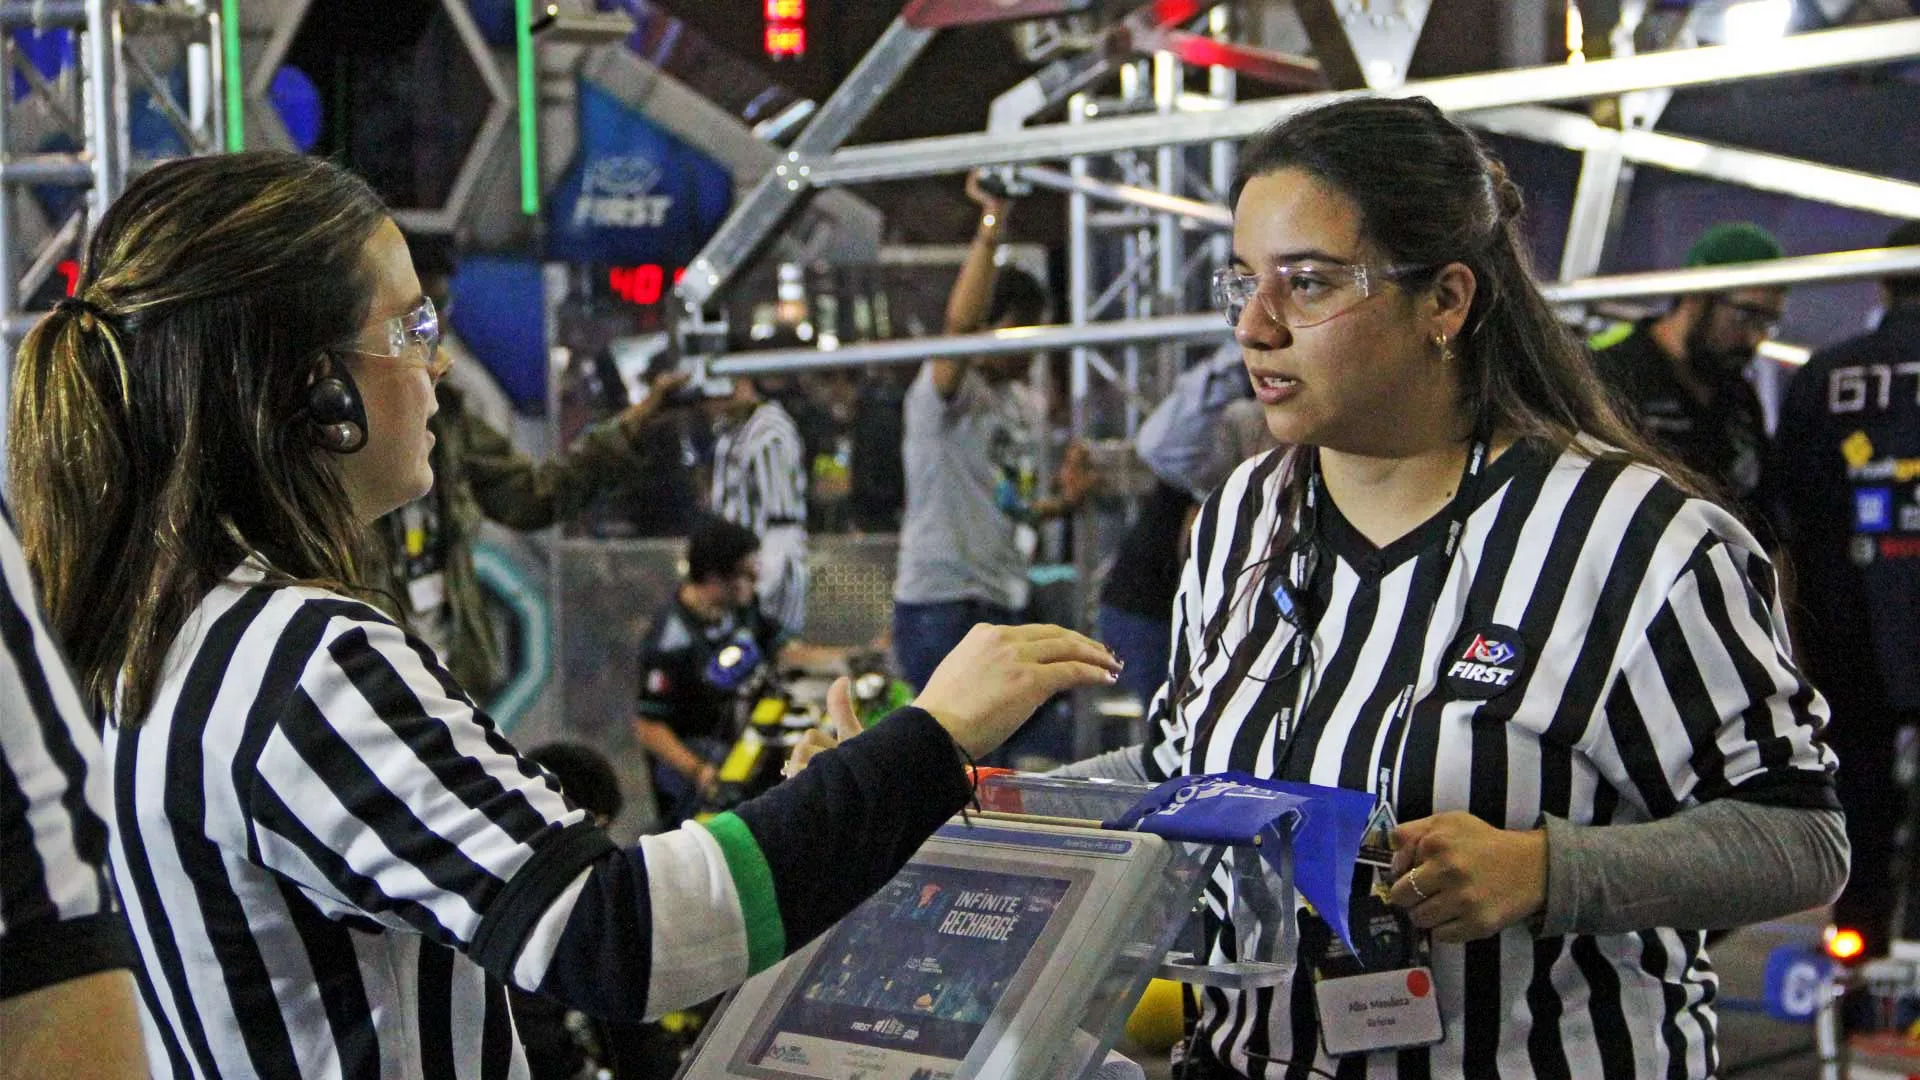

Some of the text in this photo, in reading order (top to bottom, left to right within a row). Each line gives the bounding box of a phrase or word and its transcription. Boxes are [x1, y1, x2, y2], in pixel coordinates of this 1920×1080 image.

[1447, 660, 1514, 686] FIRST
[955, 889, 1021, 913] INFINITE
[939, 909, 1019, 941] RECHARGE
